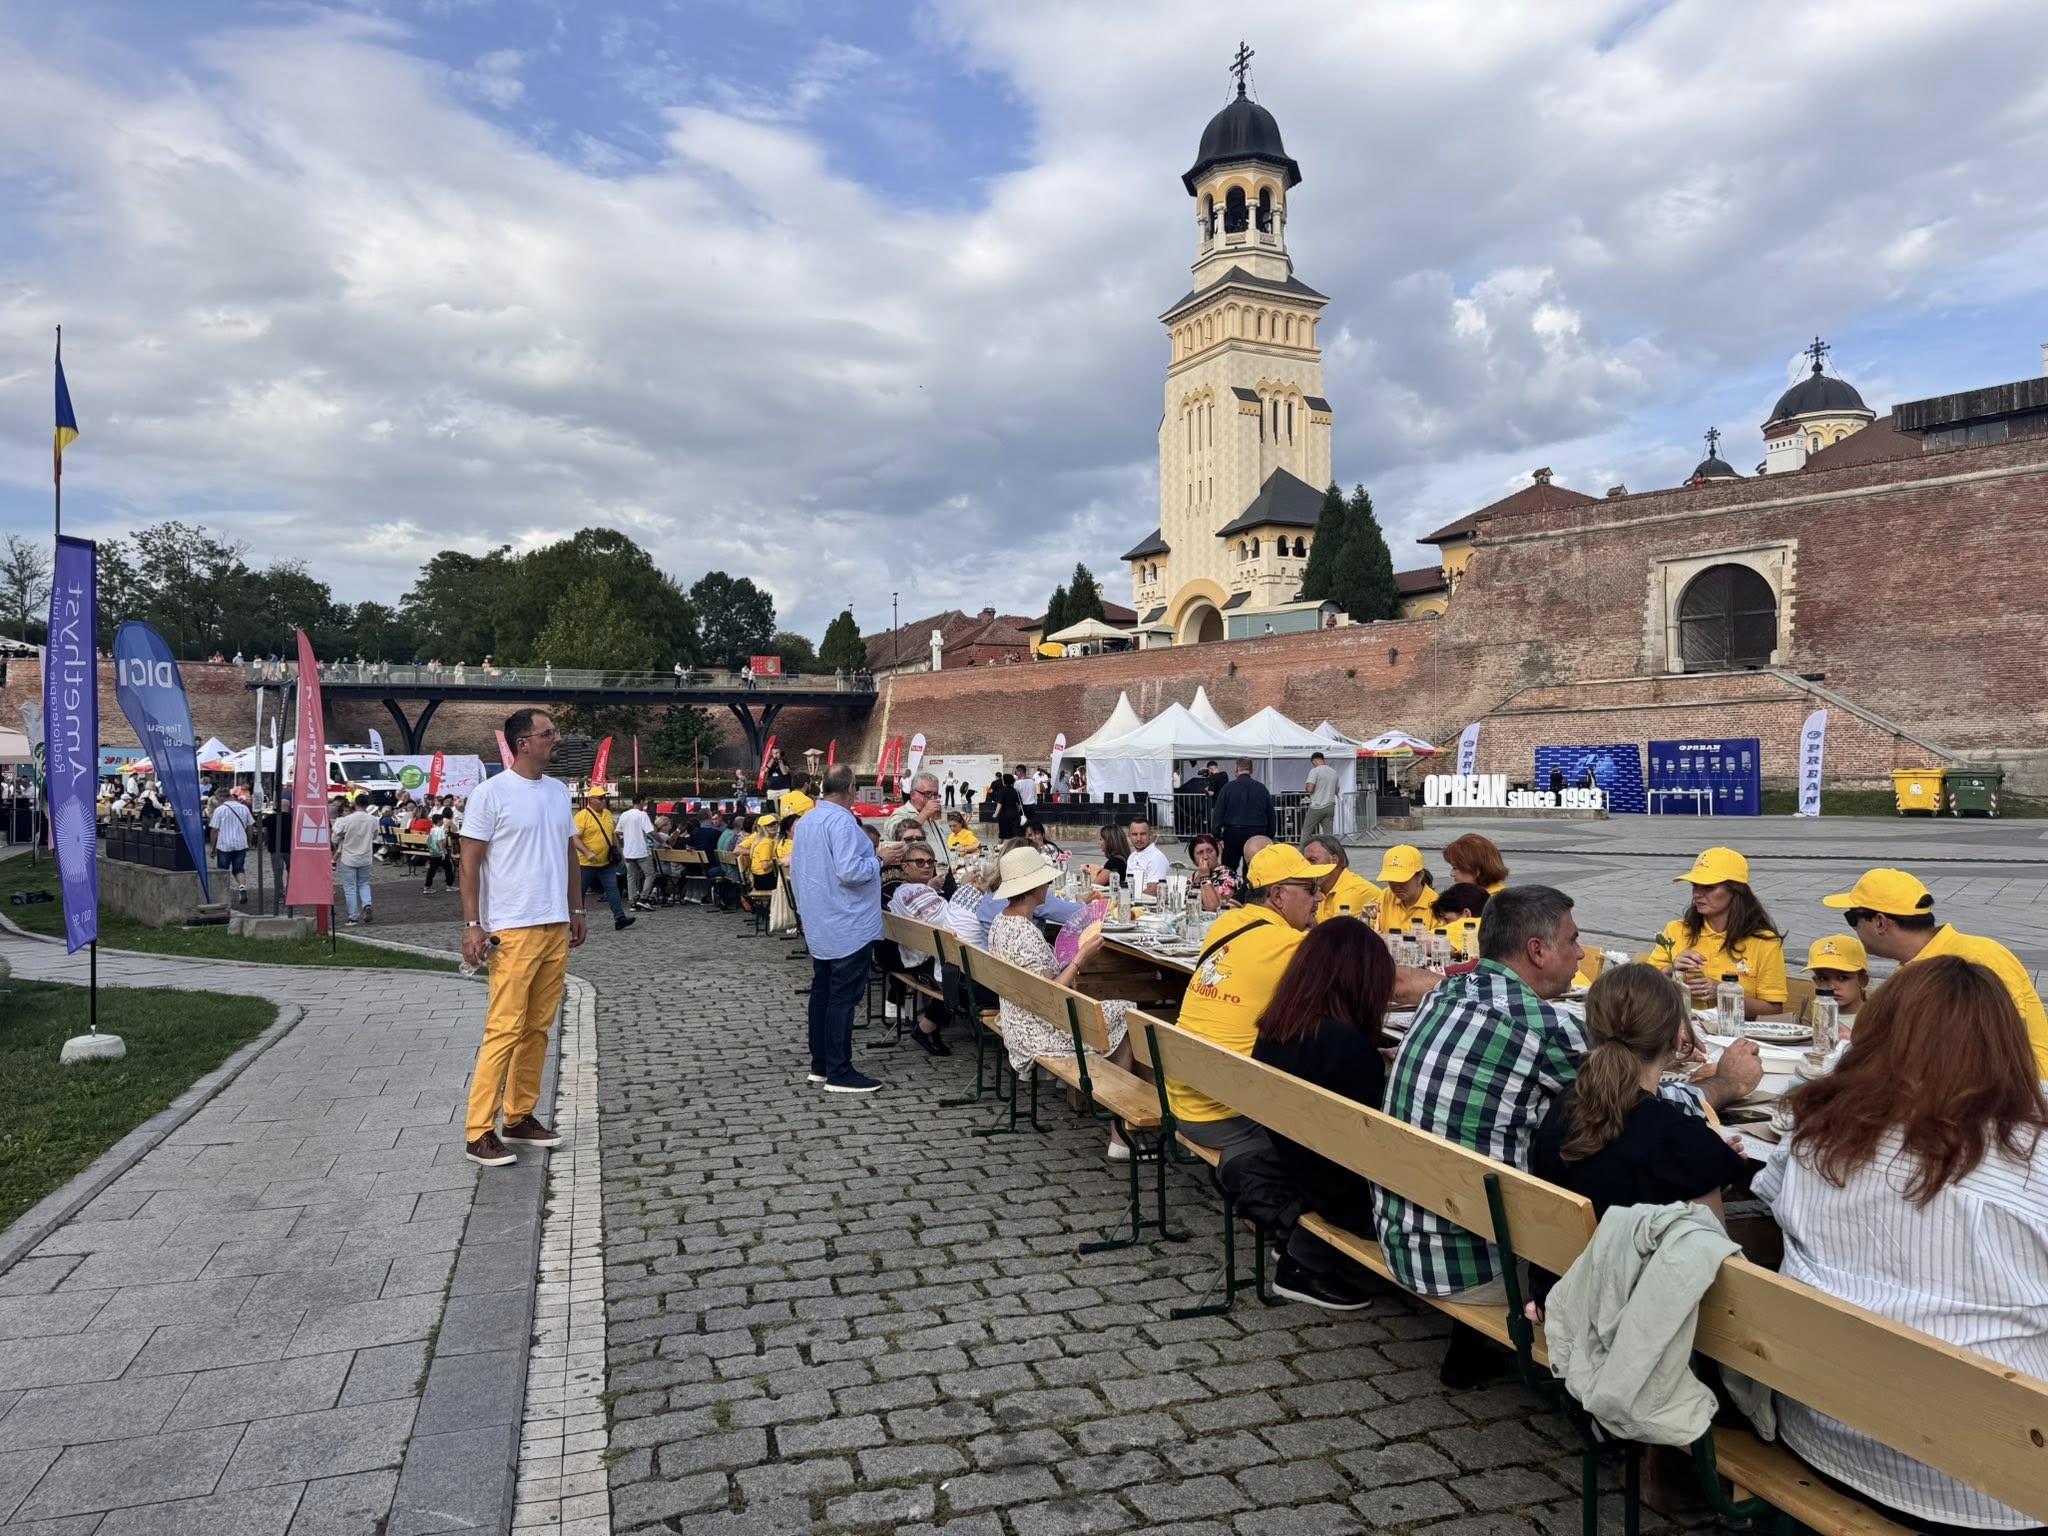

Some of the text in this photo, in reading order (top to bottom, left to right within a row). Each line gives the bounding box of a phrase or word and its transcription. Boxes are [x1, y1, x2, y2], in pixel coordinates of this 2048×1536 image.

[1462, 740, 1475, 775] OPR
[1805, 730, 1822, 805] OPREAN
[1424, 774, 1603, 808] OPREAN since 1993
